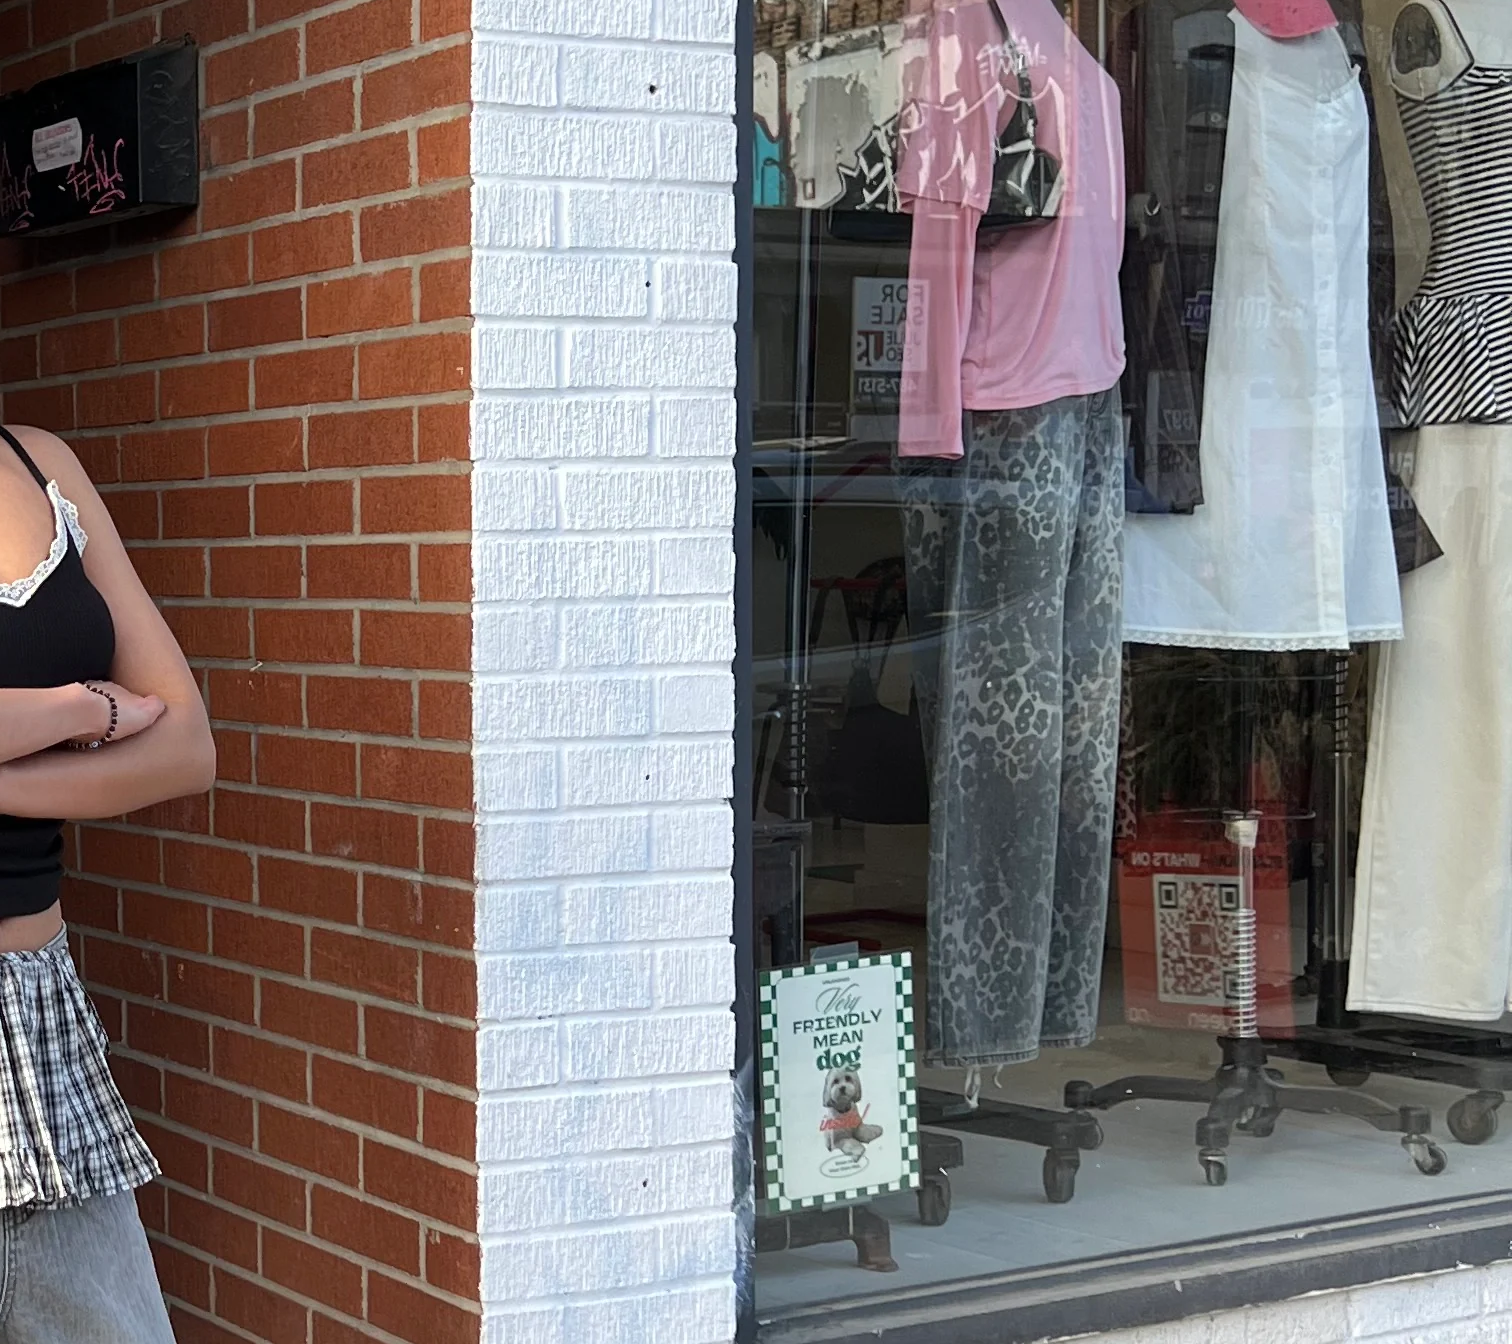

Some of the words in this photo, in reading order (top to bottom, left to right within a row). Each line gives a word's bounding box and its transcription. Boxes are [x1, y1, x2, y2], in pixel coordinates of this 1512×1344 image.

[815, 983, 862, 1015] Very
[792, 1008, 882, 1035] FRIENDLY
[813, 1029, 864, 1049] MEAN
[816, 1046, 861, 1072] dog
